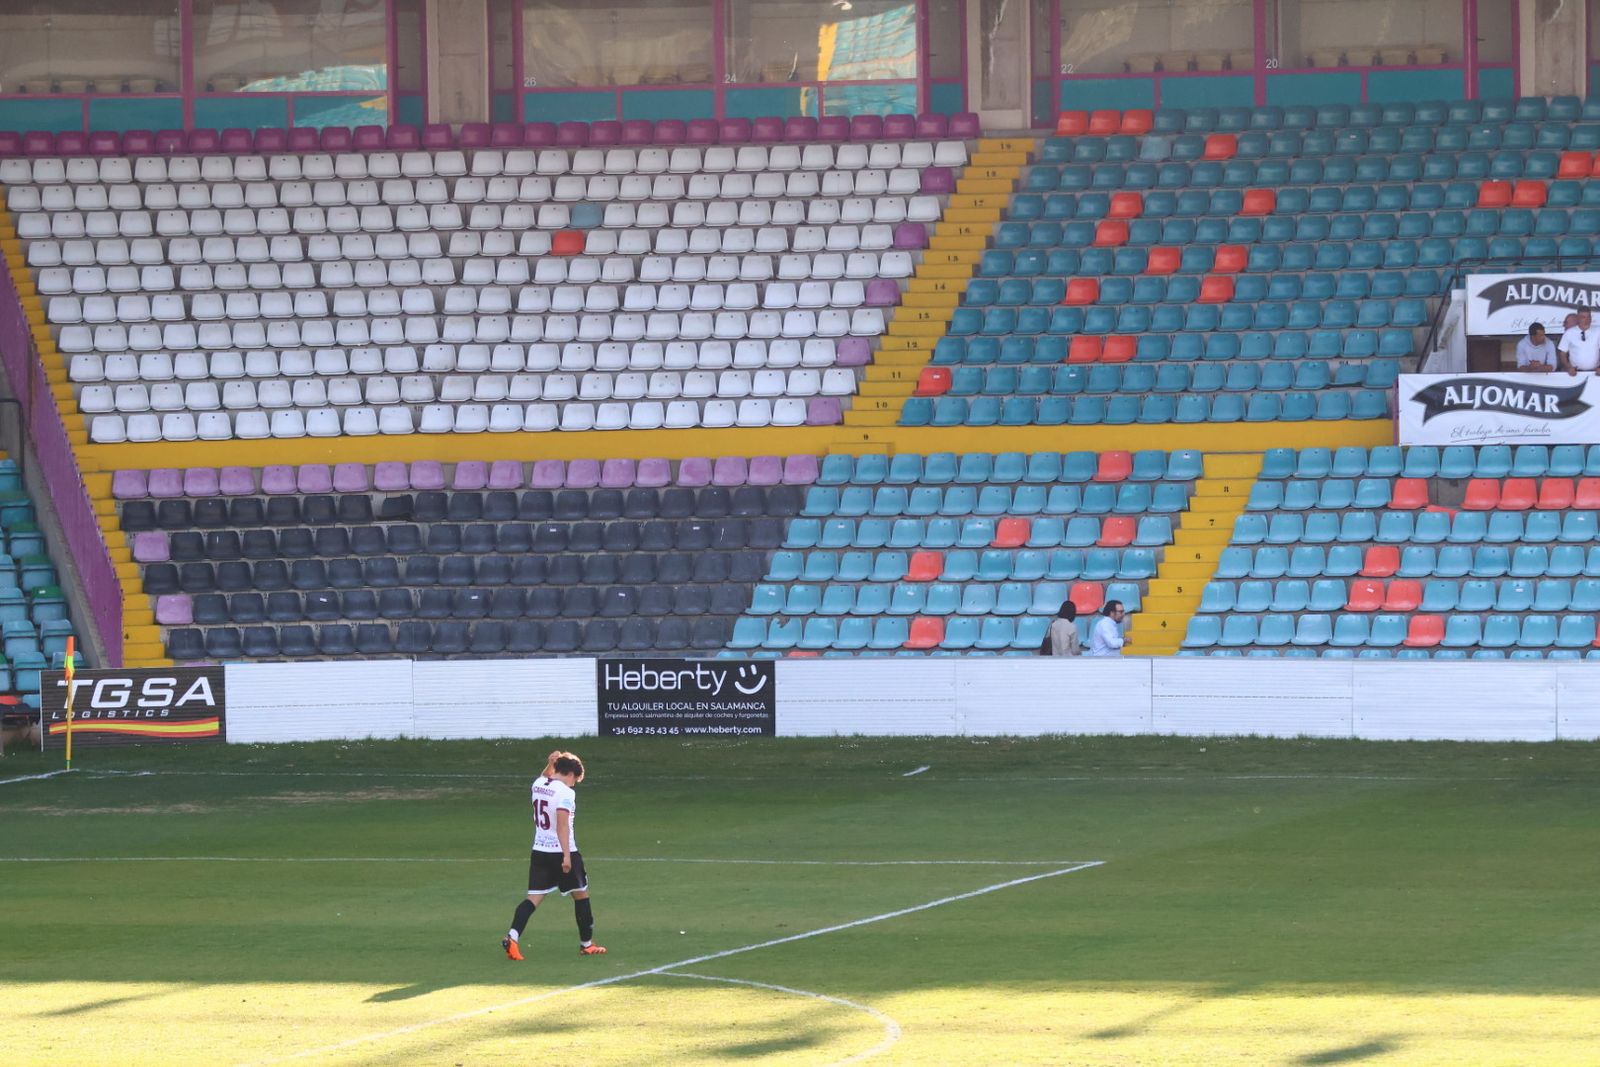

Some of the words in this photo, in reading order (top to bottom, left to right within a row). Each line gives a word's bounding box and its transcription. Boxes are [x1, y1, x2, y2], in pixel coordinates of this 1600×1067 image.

[1061, 64, 1073, 74] 22
[1266, 59, 1278, 69] 20
[524, 77, 537, 87] 26
[725, 74, 737, 84] 24
[1505, 283, 1600, 308] ALJOMAR
[1443, 384, 1560, 413] ALJOMAR
[605, 663, 727, 696] Heberty
[57, 676, 216, 709] TGSA
[608, 702, 619, 710] TU
[621, 702, 664, 710] ALQUILER
[666, 702, 694, 710] LOCAL
[697, 702, 708, 710] EN
[711, 702, 766, 710] SALAMANCA
[612, 727, 625, 735] +34
[628, 725, 643, 735] 692
[645, 727, 655, 735] 25
[657, 727, 667, 735] 43
[669, 727, 679, 735] 45
[685, 725, 762, 735] www.heberty.com
[533, 799, 550, 830] 15
